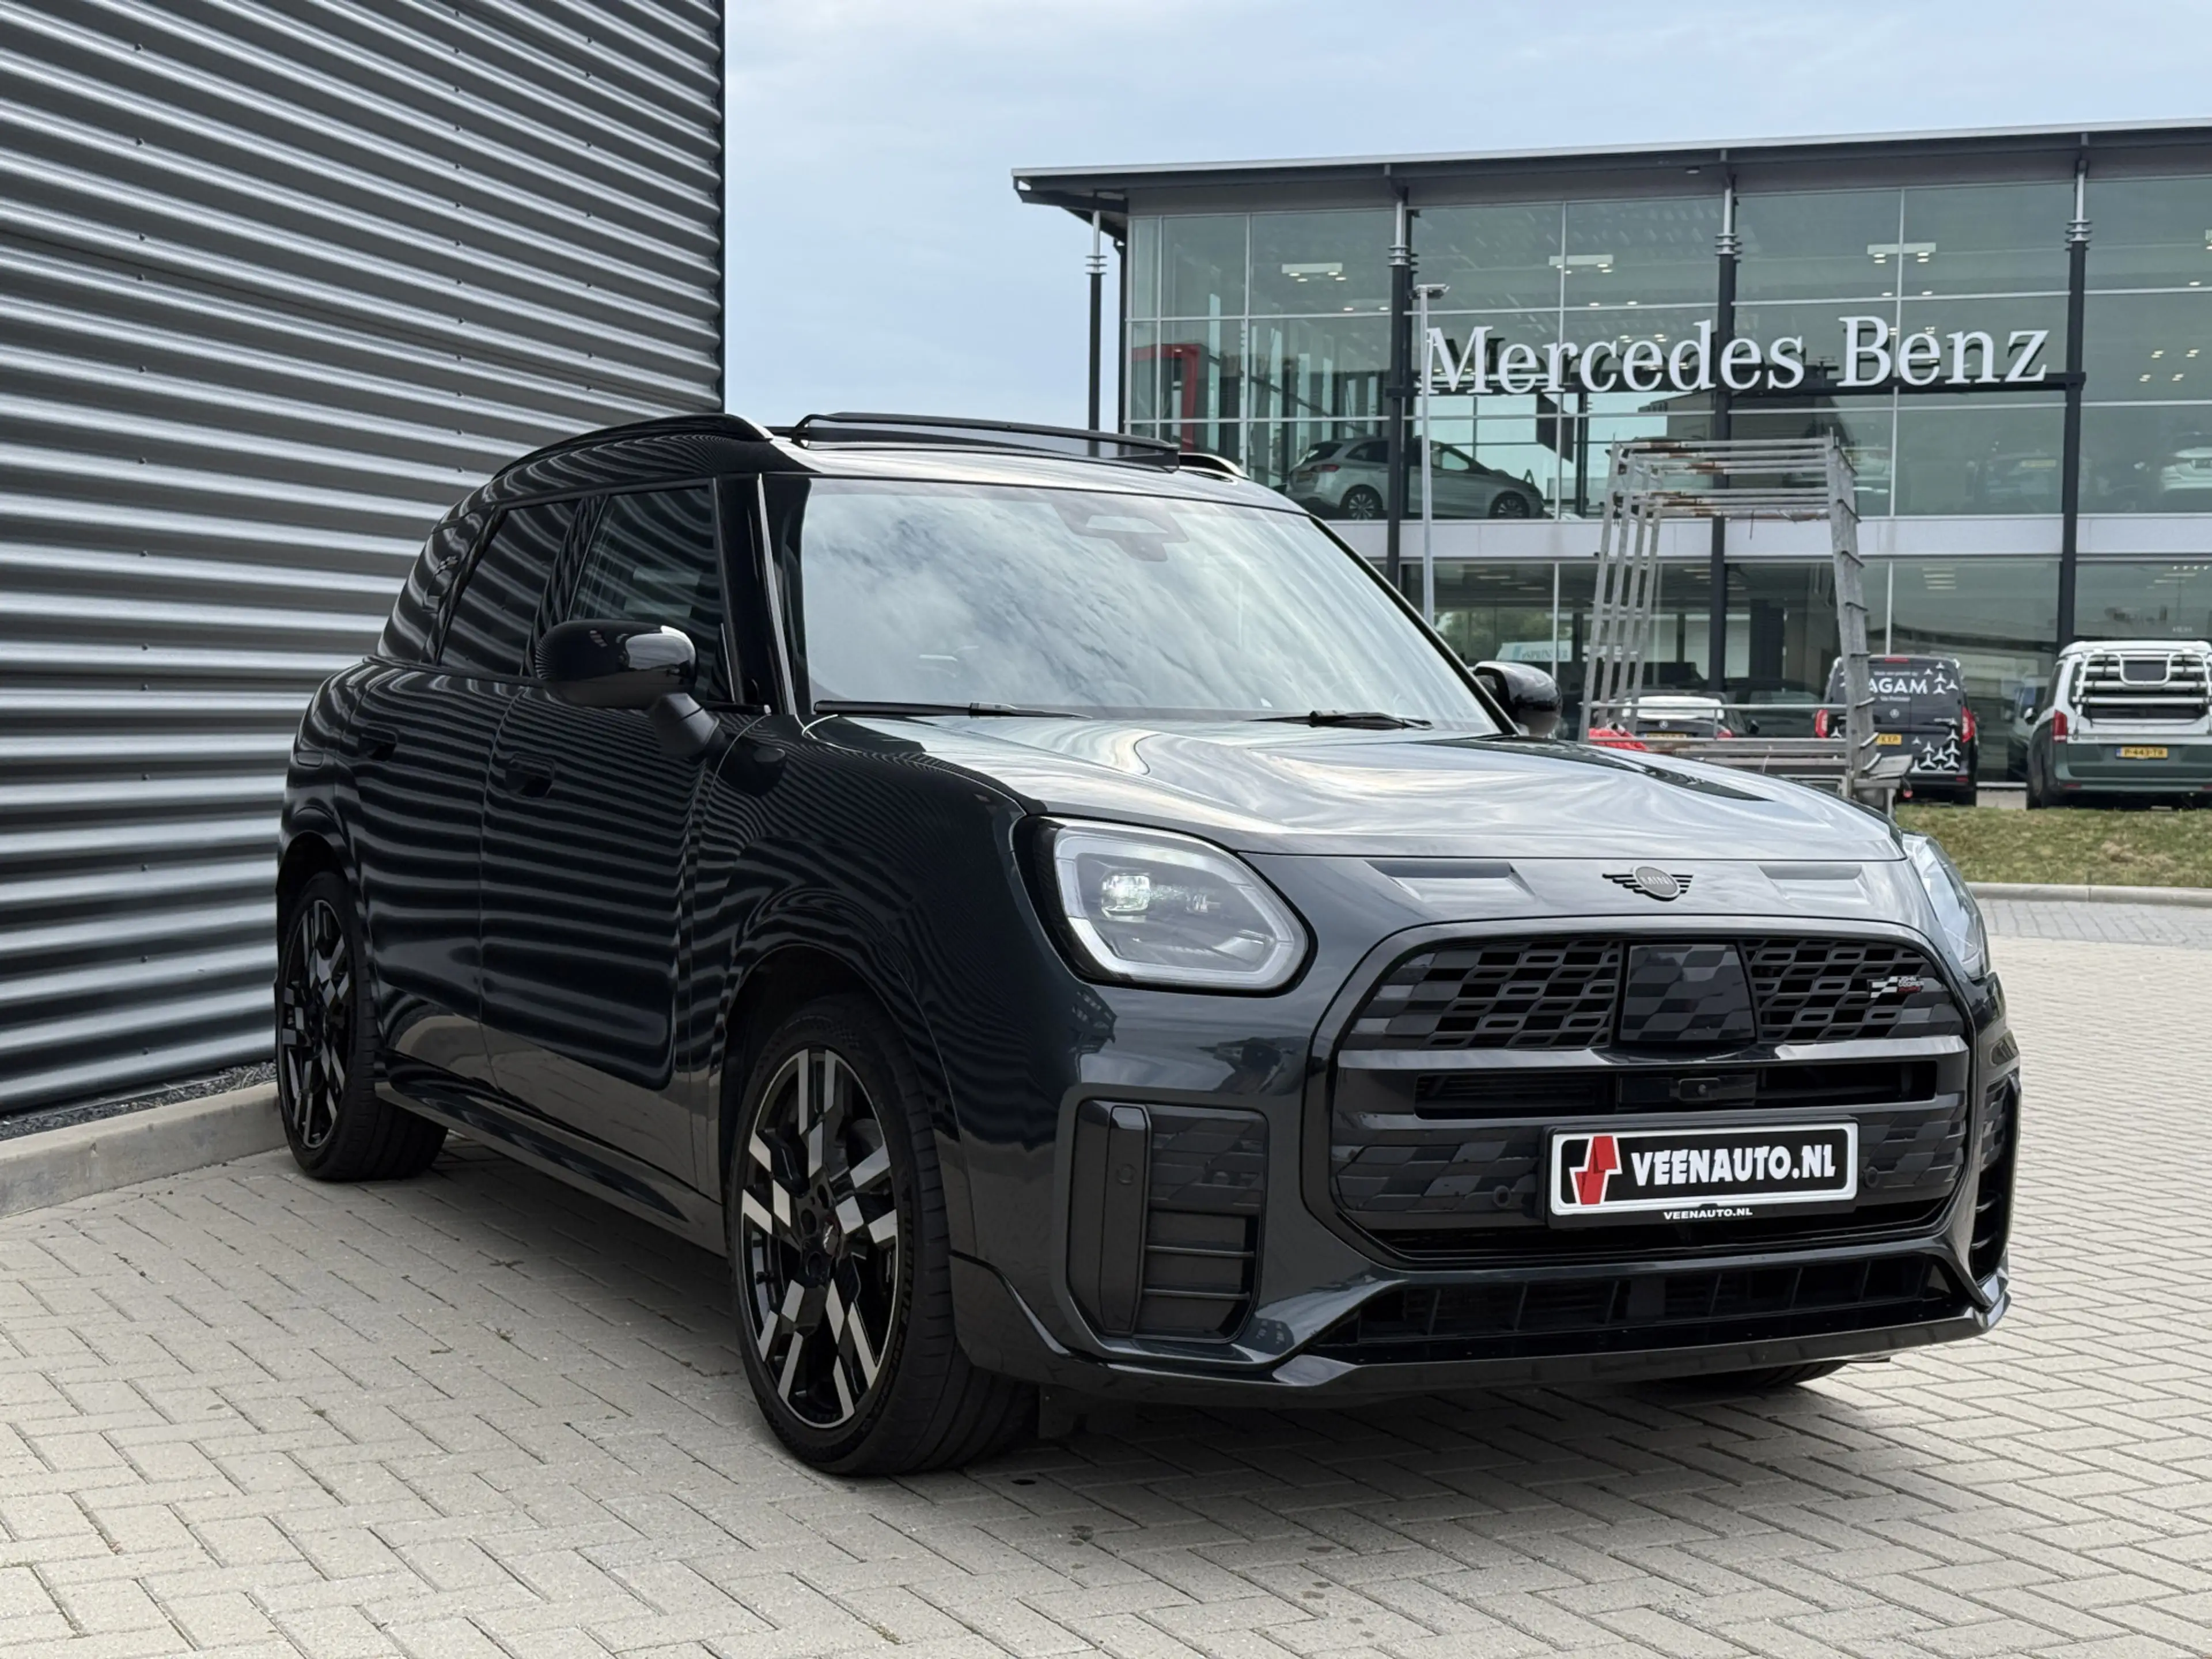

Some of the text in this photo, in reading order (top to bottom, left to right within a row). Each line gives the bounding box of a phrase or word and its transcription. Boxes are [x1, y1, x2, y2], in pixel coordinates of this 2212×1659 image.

[1418, 315, 2050, 395] Mercedes Benz
[1641, 875, 1674, 885] MINI
[1631, 1143, 1836, 1187] VEENAUTO.NL
[1664, 1207, 1753, 1220] VEENAUTO.NL
